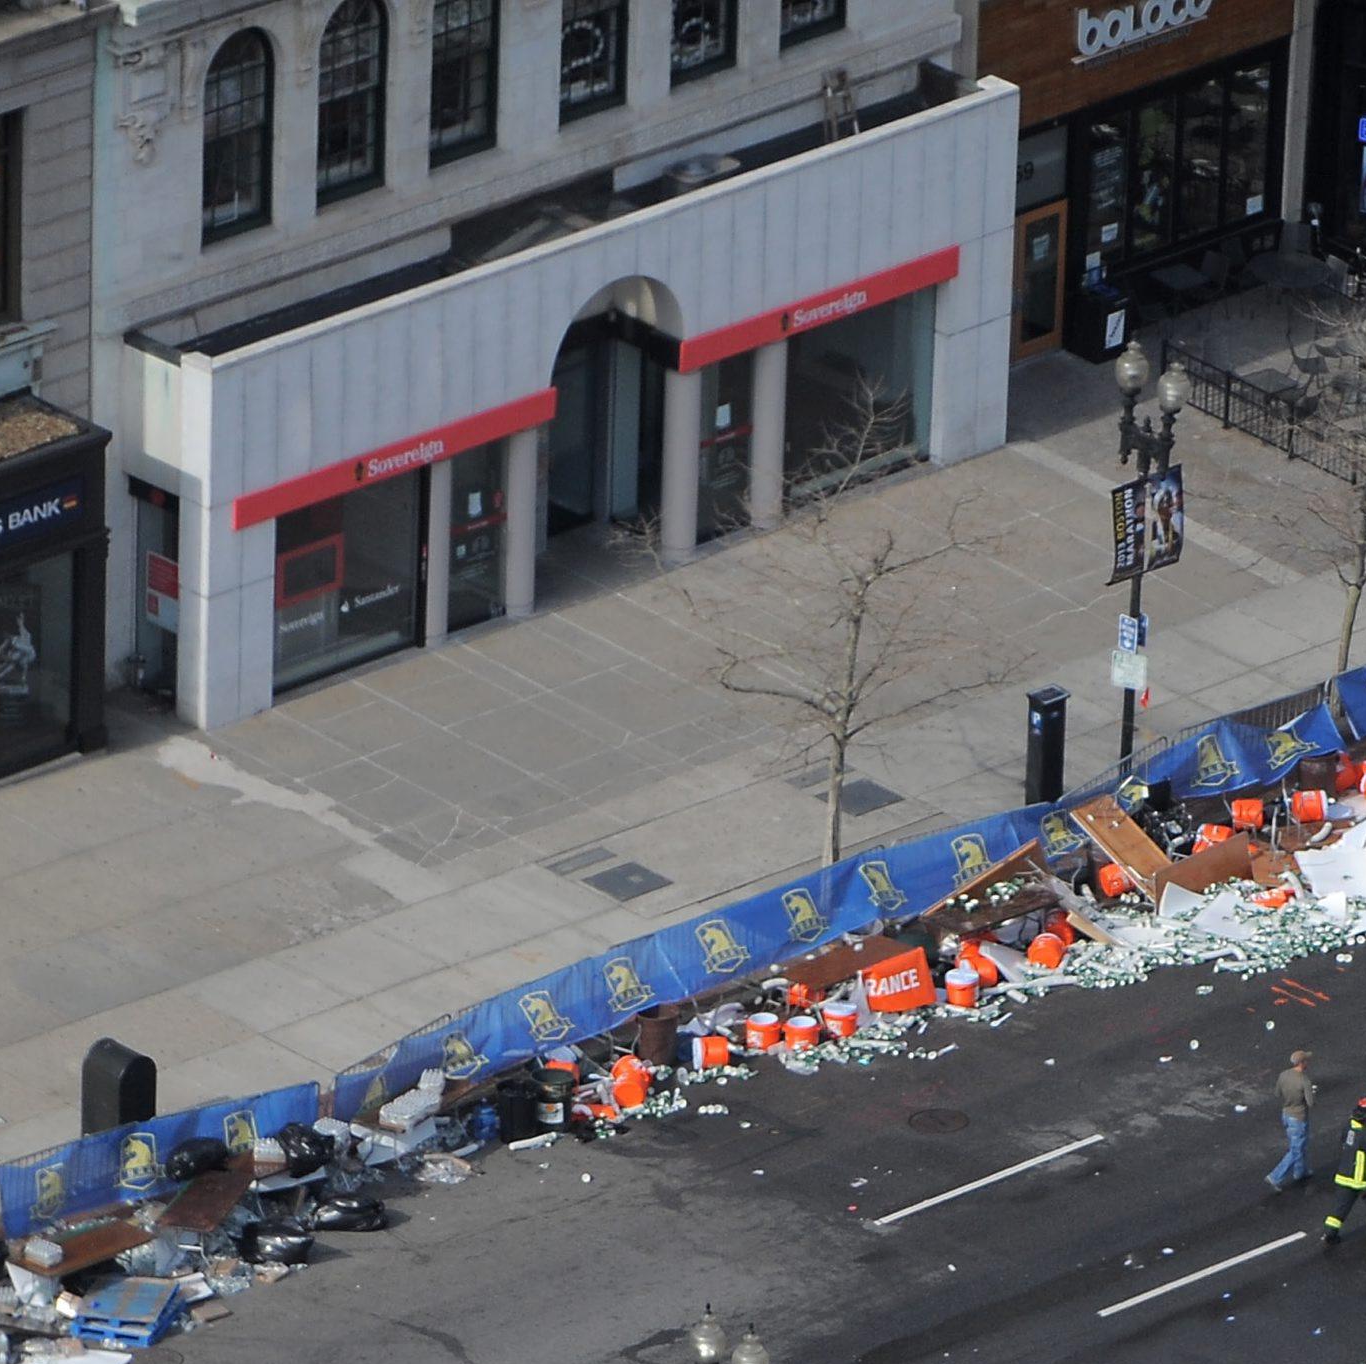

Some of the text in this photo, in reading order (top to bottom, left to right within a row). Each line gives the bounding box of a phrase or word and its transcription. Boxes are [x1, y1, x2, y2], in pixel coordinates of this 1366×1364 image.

[793, 290, 868, 327] Sovereign
[367, 440, 445, 479] Sovereign
[8, 498, 61, 530] BANK
